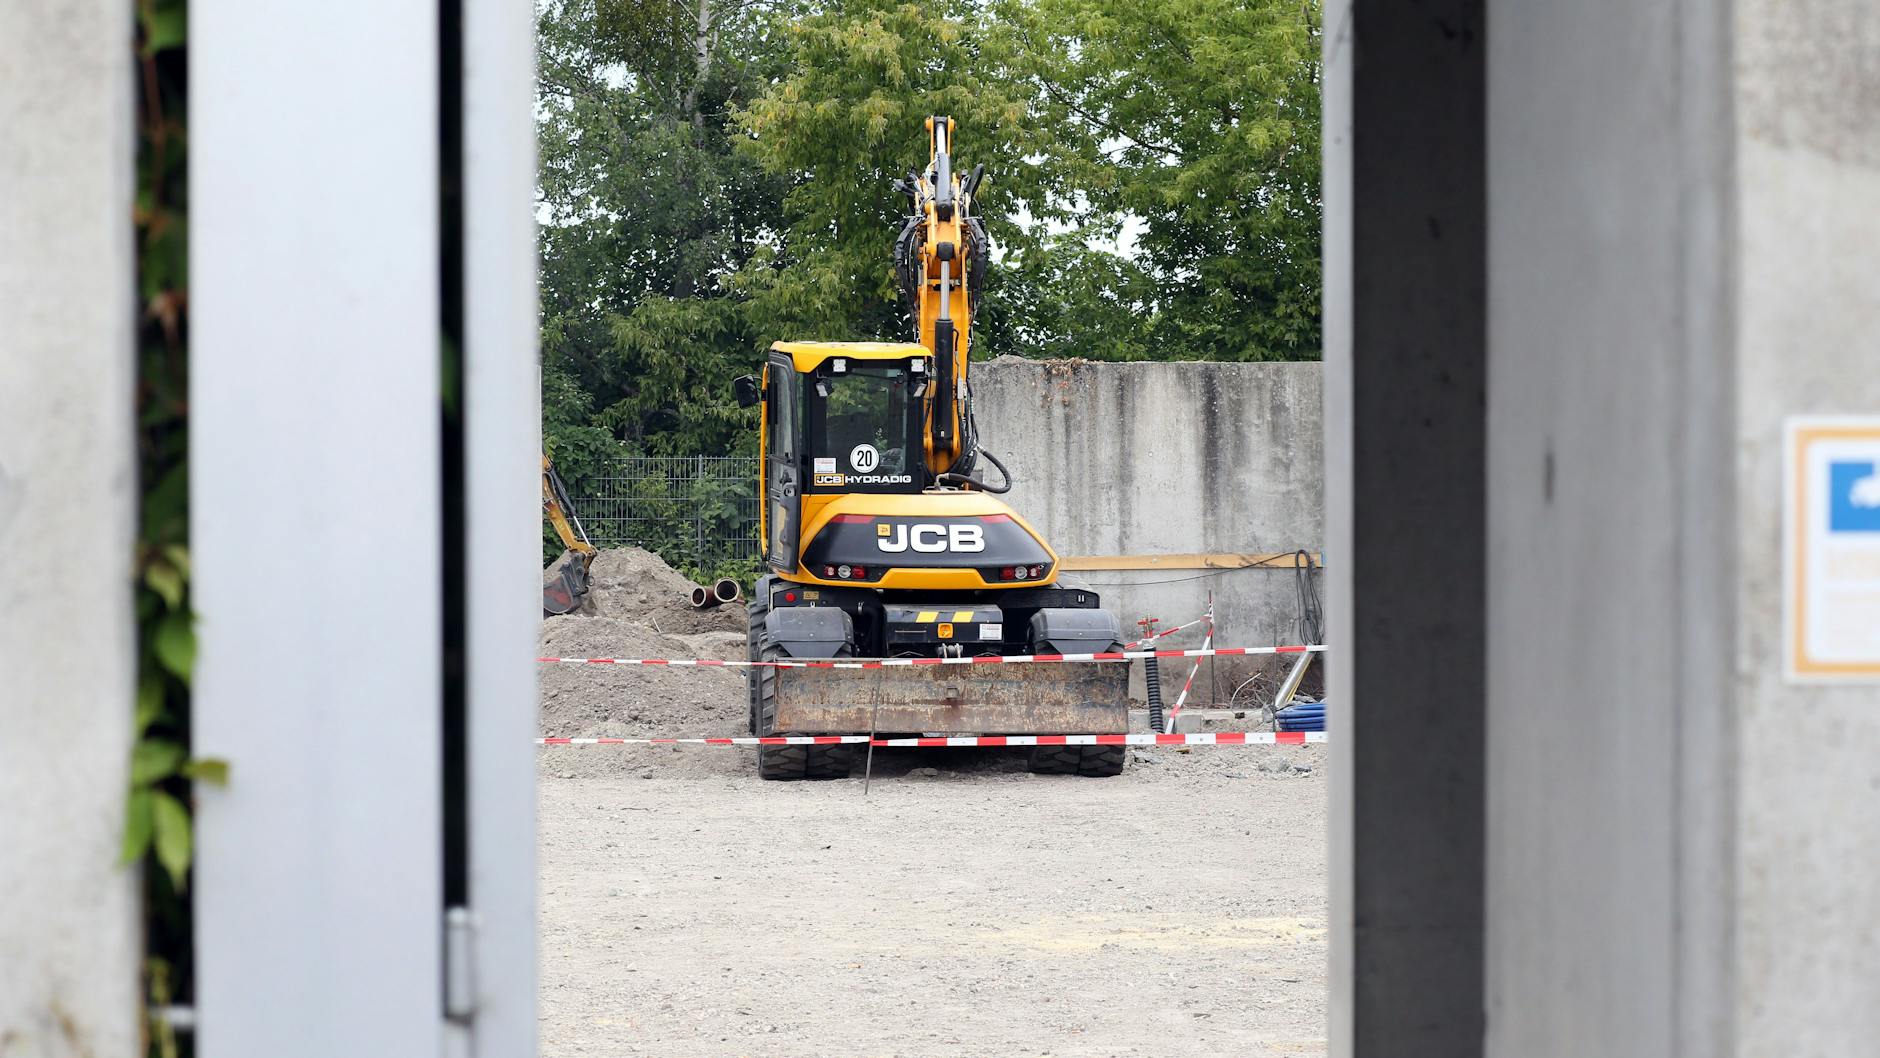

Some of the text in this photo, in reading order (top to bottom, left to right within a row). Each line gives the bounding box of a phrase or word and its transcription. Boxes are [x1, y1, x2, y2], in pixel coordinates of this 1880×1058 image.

[857, 450, 872, 467] 20
[816, 475, 911, 484] JCB HYDRADIG
[877, 524, 985, 553] JCB
